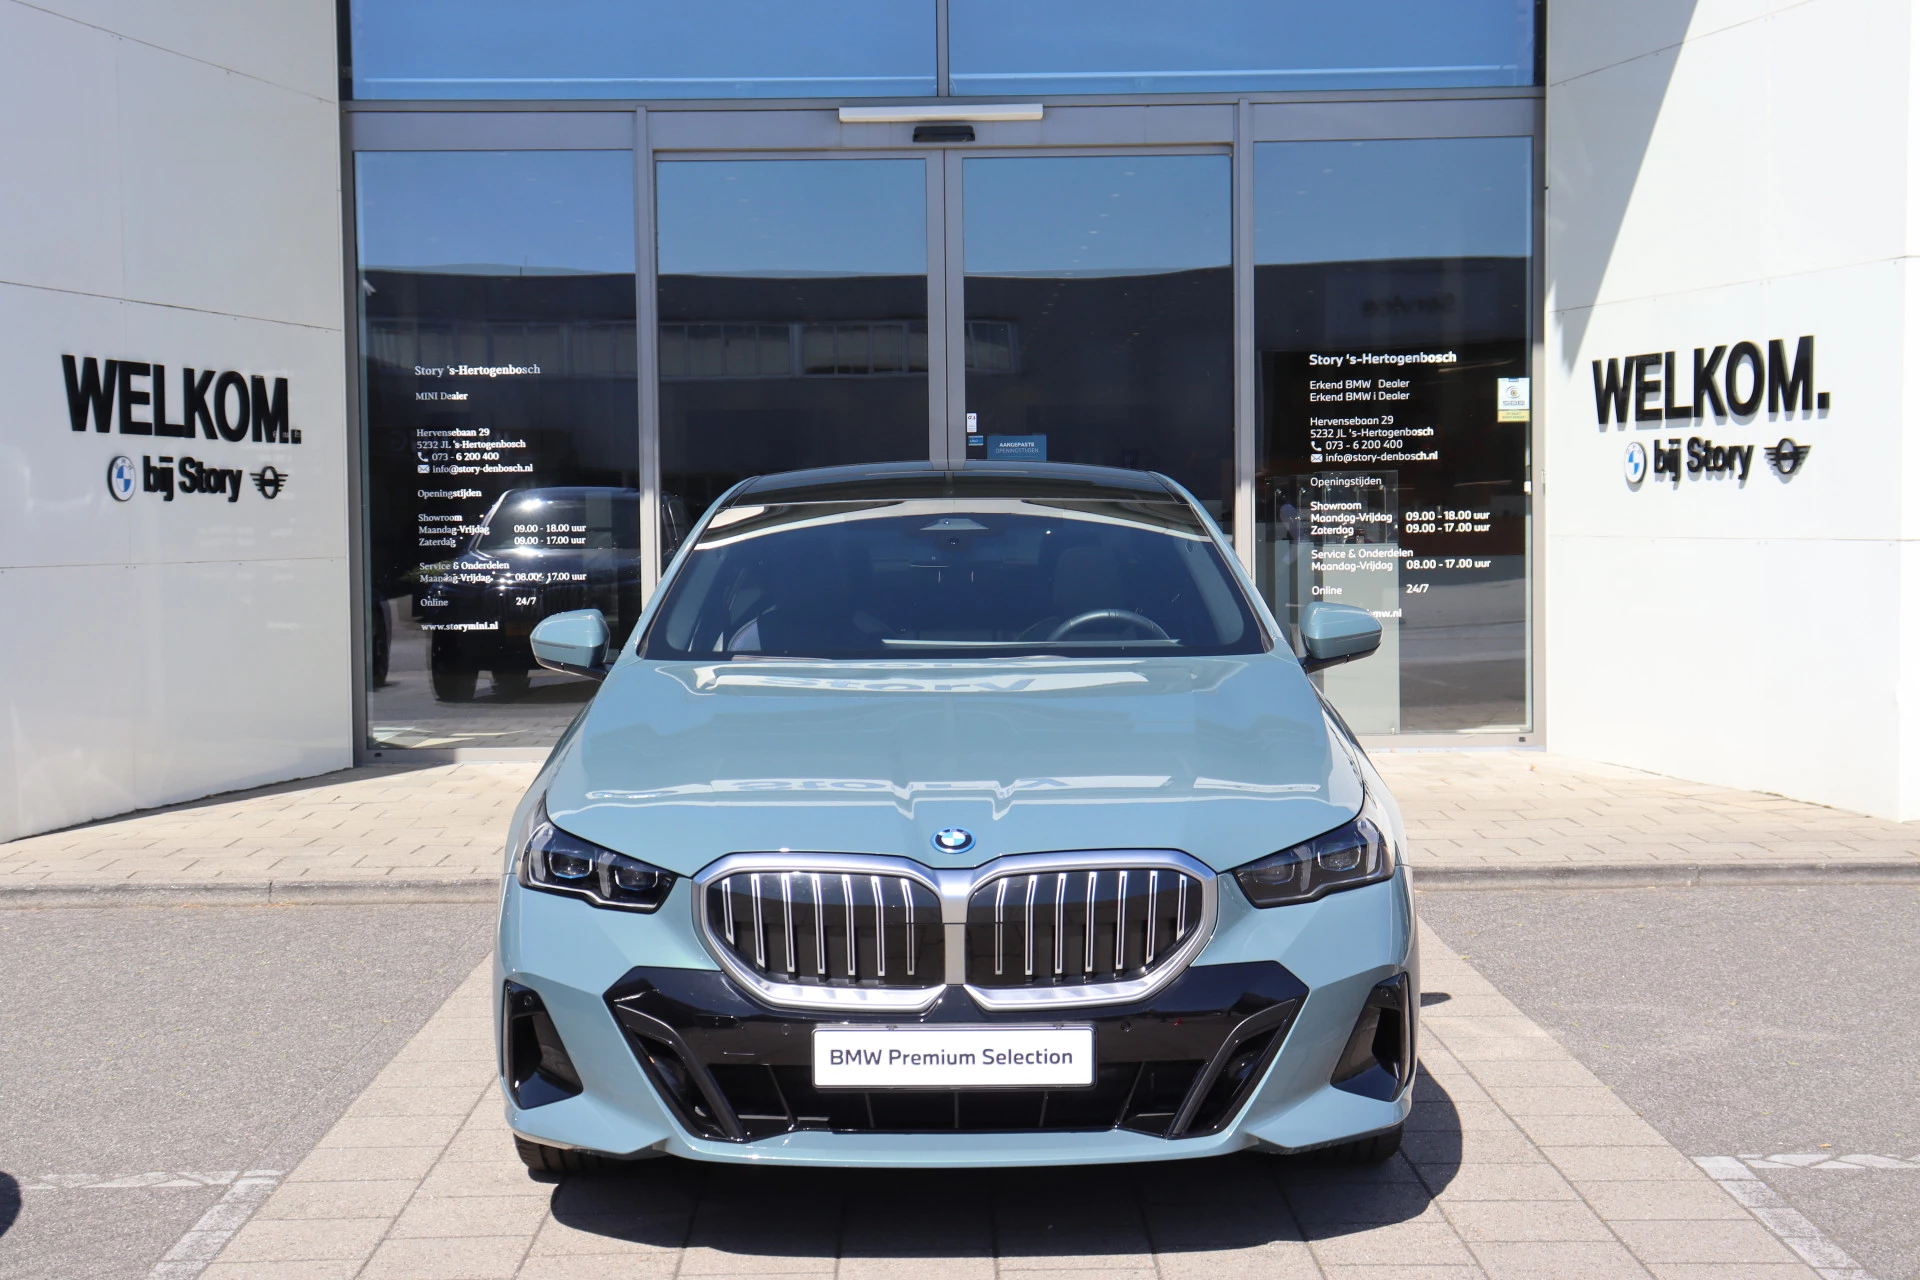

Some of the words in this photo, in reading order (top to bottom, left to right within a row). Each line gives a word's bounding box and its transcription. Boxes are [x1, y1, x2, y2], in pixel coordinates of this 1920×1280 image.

[1309, 353, 1344, 367] Story
[1346, 351, 1457, 366] 's-Hertogenbosch
[414, 365, 444, 378] Story
[446, 364, 541, 377] 's-Hertogenbosch
[1310, 380, 1343, 389] Erkend
[1345, 379, 1371, 389] BMW
[1378, 379, 1410, 388] Dealer
[1591, 334, 1831, 425] WELKOM.
[61, 354, 302, 445] WELKOM.
[415, 392, 438, 400] MINI
[440, 392, 468, 400] Dealer
[1310, 392, 1343, 402] Erkend
[1345, 391, 1371, 401] BMW
[1373, 391, 1376, 400] i
[1378, 391, 1410, 401] Dealer
[1310, 417, 1379, 426] Hervensebaan
[1380, 416, 1394, 425] 29
[416, 428, 477, 437] Hervensebaan
[478, 428, 490, 436] 29
[1310, 429, 1334, 438] 5232
[1336, 429, 1347, 438] JL
[1348, 427, 1434, 438] 's-Hertogenbosch
[416, 441, 439, 449] 5232
[440, 441, 451, 449] JL
[452, 440, 526, 450] 's-Hertogenbosch
[1325, 440, 1344, 450] 073
[1353, 440, 1359, 449] 6
[1361, 440, 1381, 449] 200
[1383, 439, 1403, 449] 400
[431, 453, 449, 461] 073
[455, 452, 463, 461] 6
[463, 452, 481, 461] 200
[482, 452, 499, 461] 400
[1325, 451, 1439, 463] info@story-denbosch.nl
[1687, 436, 1755, 480] Story
[432, 464, 533, 475] info@story-denbosch.nl
[178, 456, 243, 503] Story
[1310, 476, 1382, 487] Openingstijden
[417, 489, 482, 500] Openingstijden
[1310, 501, 1362, 511] Showroom
[418, 514, 463, 522] Showroom
[1311, 513, 1393, 524] Maandag-Vrijdag
[1405, 511, 1436, 521] 09.00
[1444, 511, 1472, 520] 18.00
[1474, 512, 1490, 520] uur
[418, 525, 490, 535] Maandag-Vrijdag
[513, 524, 539, 533] 09.00
[546, 524, 570, 533] 18.00
[571, 524, 586, 532] uur
[1311, 525, 1354, 536] Zaterdag
[1405, 523, 1436, 533] 09.00
[1444, 523, 1472, 532] 17.00
[1474, 523, 1491, 532] uur
[419, 538, 457, 548] Zaterdag
[514, 536, 539, 545] 09.00
[546, 536, 570, 544] 17.00
[1311, 549, 1346, 559] Service
[1348, 548, 1356, 558] &
[1358, 548, 1414, 558] Onderdelen
[419, 562, 451, 571] Service
[453, 562, 459, 570] &
[461, 561, 510, 570] Onderdelen
[1311, 561, 1393, 572] Maandag-Vrijdag
[1406, 559, 1436, 569] 08.00
[1444, 559, 1473, 569] 17.00
[1474, 560, 1491, 568] uur
[419, 573, 491, 584] Maandag-Vrijdag
[515, 572, 539, 581] 08.00
[547, 572, 571, 581] 17.00
[1311, 585, 1343, 595] Online
[1406, 584, 1429, 594] 24/7
[420, 598, 449, 607] Online
[515, 596, 537, 606] 24/7
[421, 621, 499, 632] www.storymini.nl
[830, 1049, 882, 1066] BMW
[889, 1048, 976, 1066] Premium
[982, 1047, 1073, 1065] Selection
